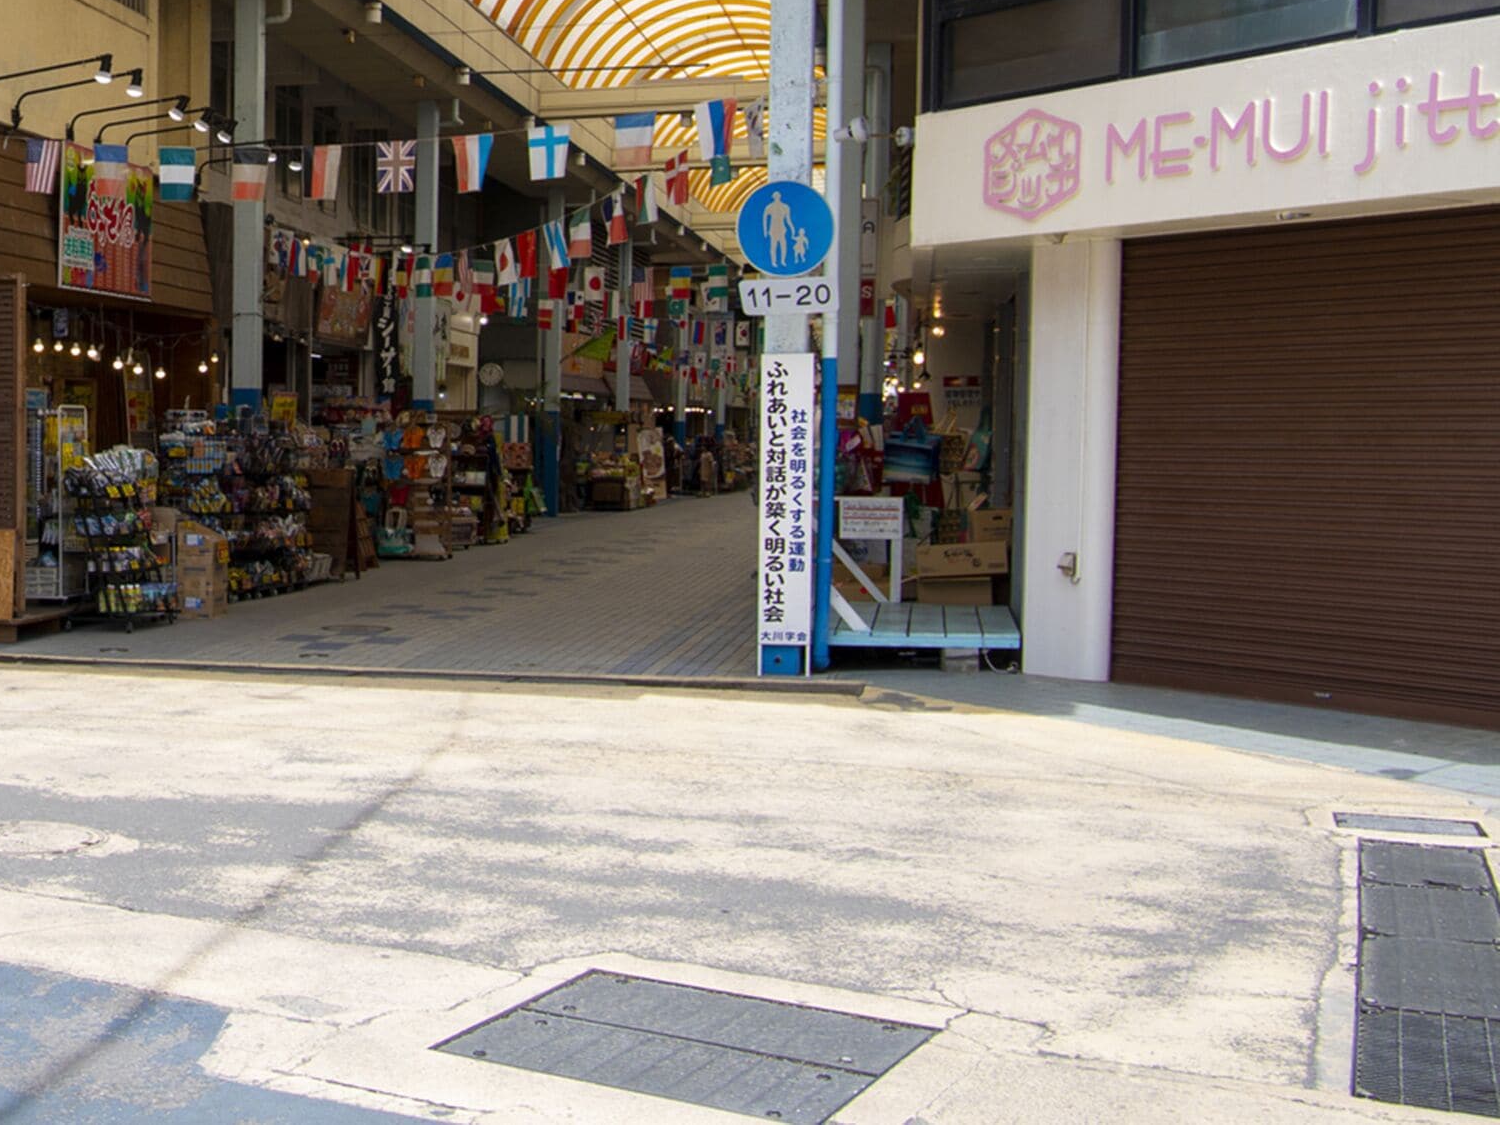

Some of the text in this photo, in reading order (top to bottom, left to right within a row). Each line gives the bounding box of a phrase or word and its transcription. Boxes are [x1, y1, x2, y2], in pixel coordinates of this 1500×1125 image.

[747, 283, 831, 308] 11-20
[763, 361, 789, 624] ふれあいと対話が築く明るい社会
[788, 408, 808, 573] 社会を明るくする運動
